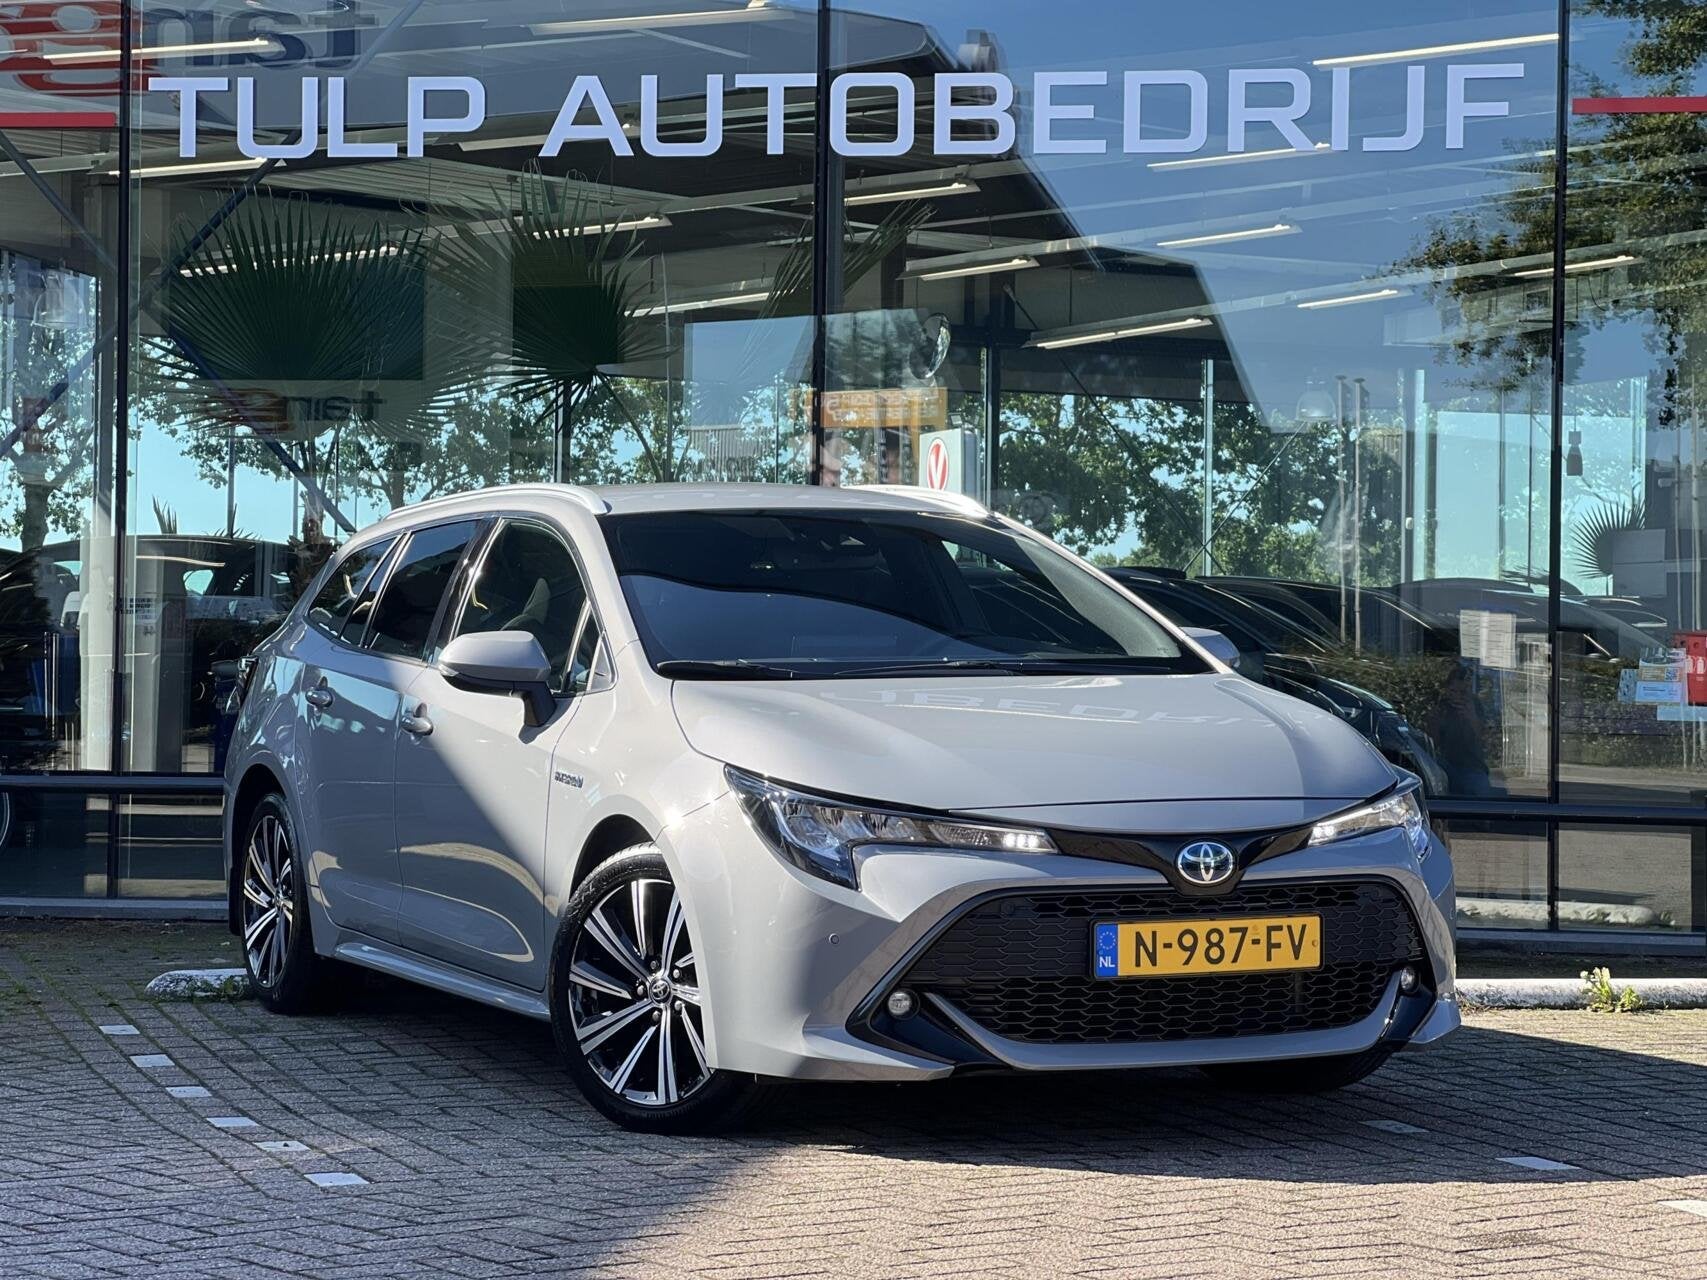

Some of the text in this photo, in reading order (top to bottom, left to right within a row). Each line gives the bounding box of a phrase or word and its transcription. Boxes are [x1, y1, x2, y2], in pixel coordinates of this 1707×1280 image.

[148, 63, 1525, 159] TULP AUTOBEDRIJF
[1099, 956, 1116, 968] NL
[1135, 924, 1307, 967] N-987-FV
